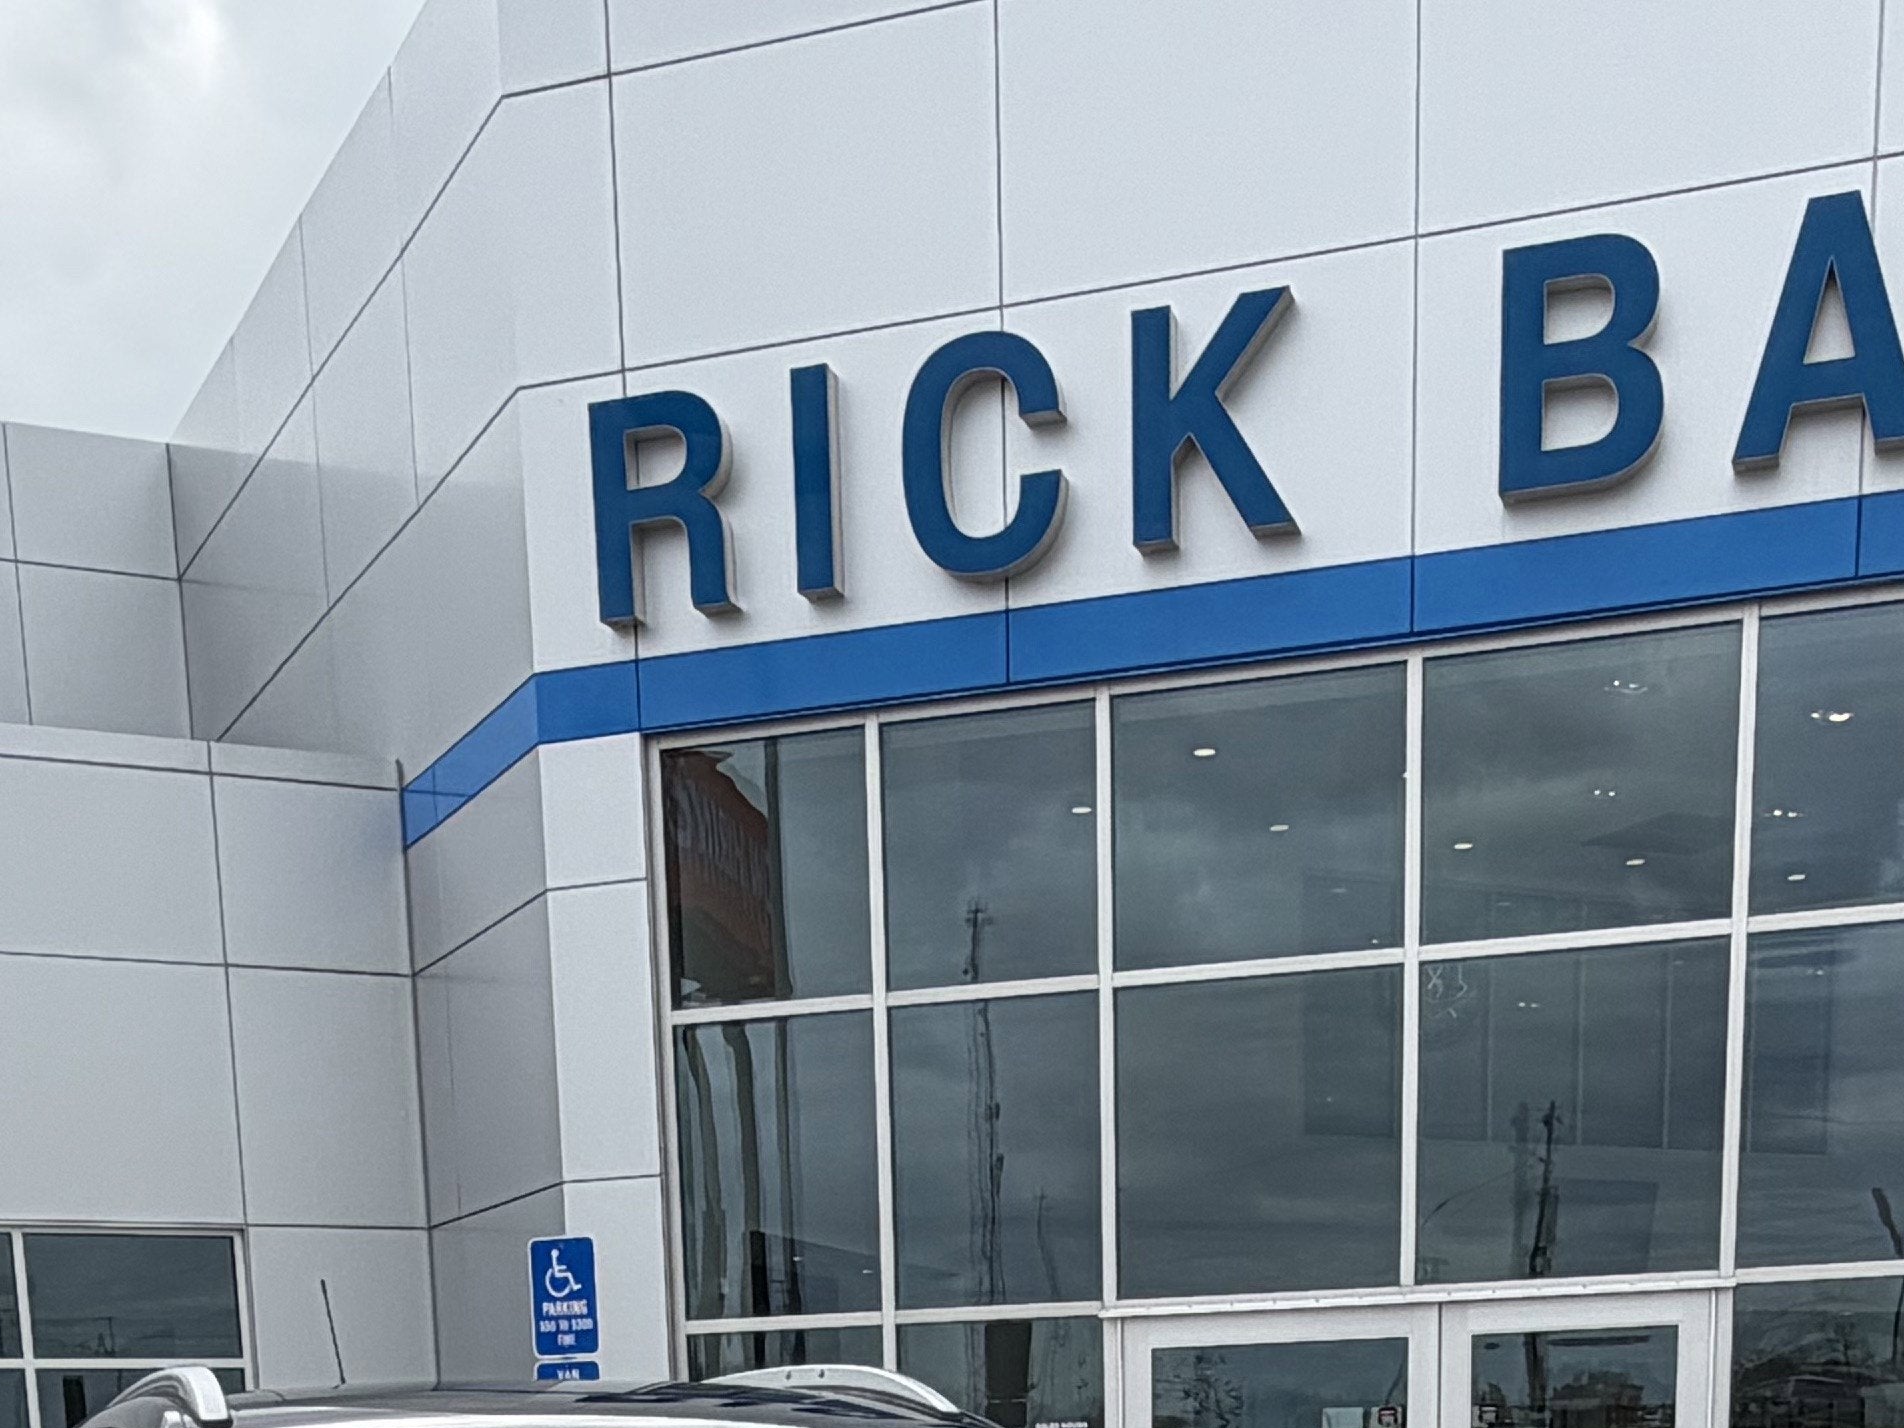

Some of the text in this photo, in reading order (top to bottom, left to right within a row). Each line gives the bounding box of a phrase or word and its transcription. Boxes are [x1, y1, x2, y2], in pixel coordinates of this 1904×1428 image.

[586, 285, 1302, 632] RICK
[542, 1299, 588, 1316] PARKING
[556, 1369, 580, 1380] VAN
